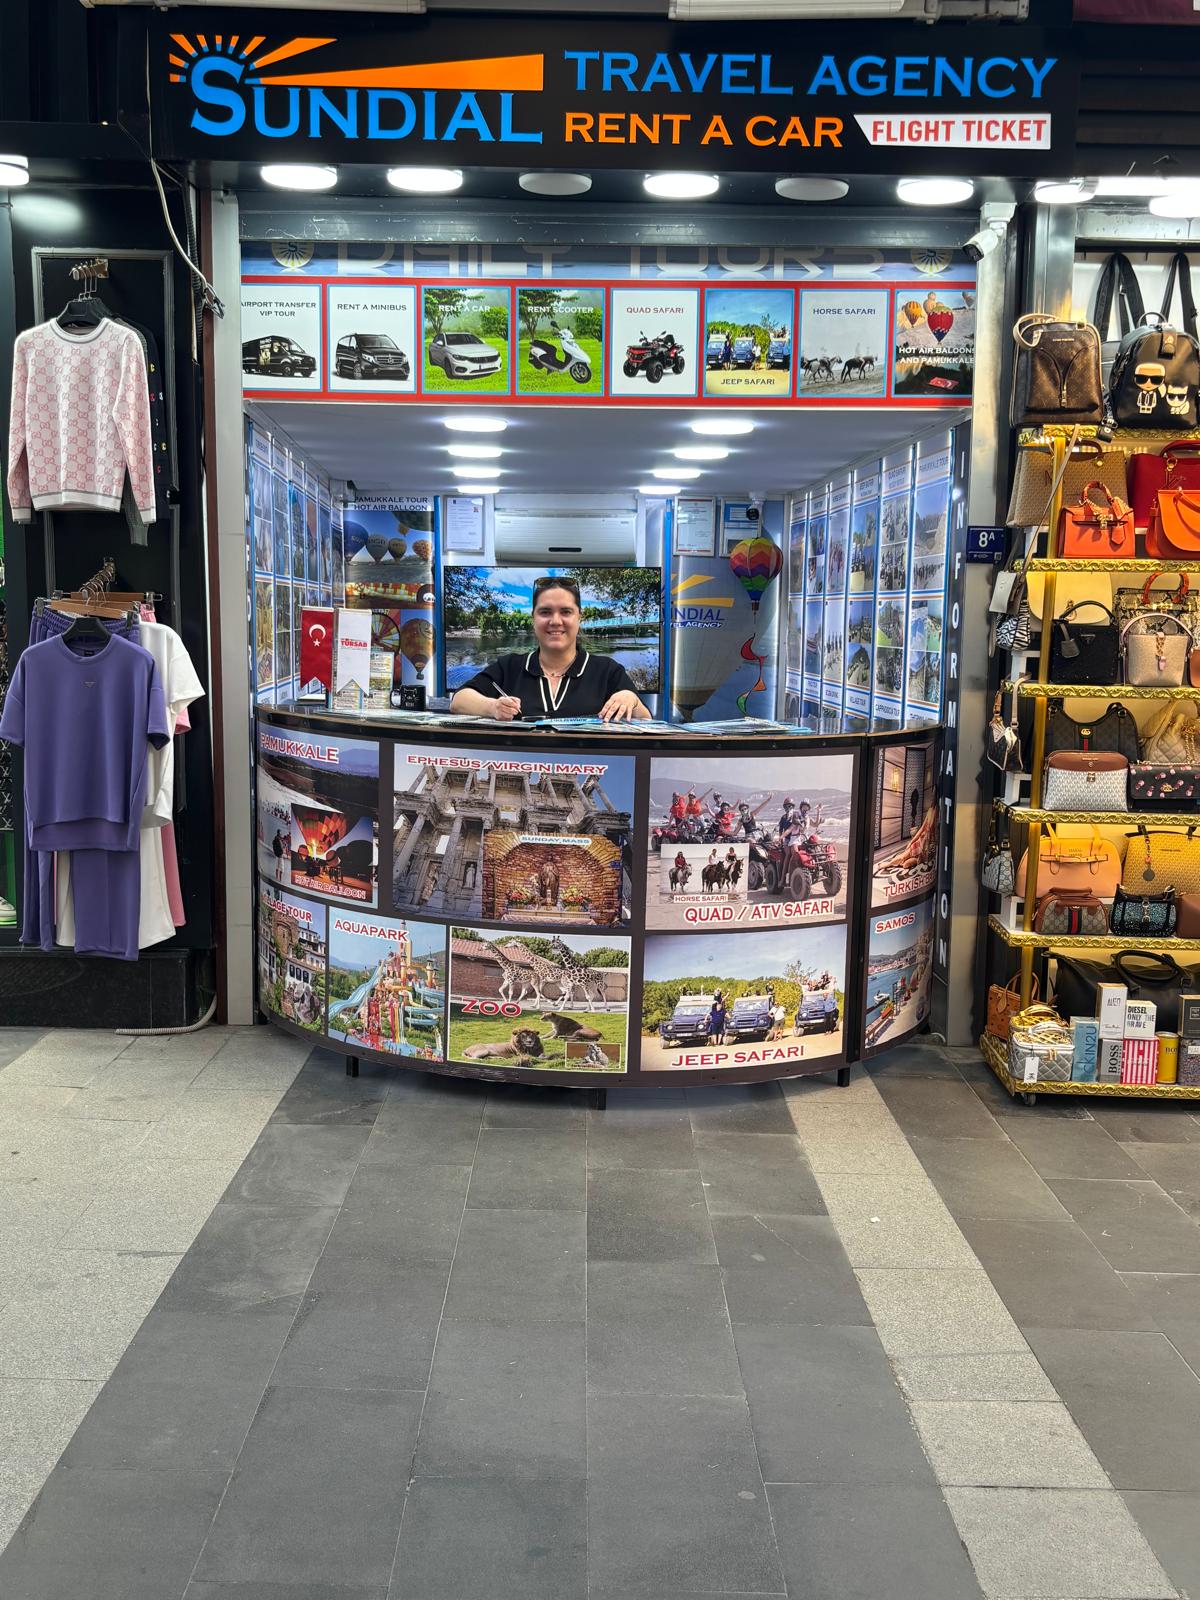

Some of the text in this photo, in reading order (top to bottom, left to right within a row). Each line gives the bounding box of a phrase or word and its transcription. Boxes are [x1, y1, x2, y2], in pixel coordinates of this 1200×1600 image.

[564, 50, 1058, 98] TRAVEL AGENCY
[191, 56, 542, 144] SUNDIAL
[564, 112, 844, 148] RENT A CAR
[872, 118, 1048, 144] FLIGHT TICKET
[275, 301, 317, 309] TRANSFER
[337, 303, 361, 311] RENT
[552, 306, 594, 314] SCOOTER
[626, 307, 651, 315] QUAD
[720, 378, 775, 386] JEEP SAFARI
[939, 450, 965, 969] INFORMATION
[260, 733, 339, 763] PAMUKKALE
[556, 764, 607, 775] MARY
[294, 874, 367, 899] HOT AIR BALLOON
[883, 876, 924, 897] TURKISH
[288, 905, 312, 922] TOUR
[685, 901, 833, 923] QUAD / ATV SAFARI
[334, 919, 408, 942] AQUAPARK
[876, 913, 915, 933] SAMOS
[462, 999, 521, 1018] ZOO
[1127, 1006, 1147, 1014] DIESEL
[1144, 1014, 1156, 1022] THE
[672, 1045, 804, 1067] JEEP SAFARI
[1107, 1044, 1120, 1074] BOSS
